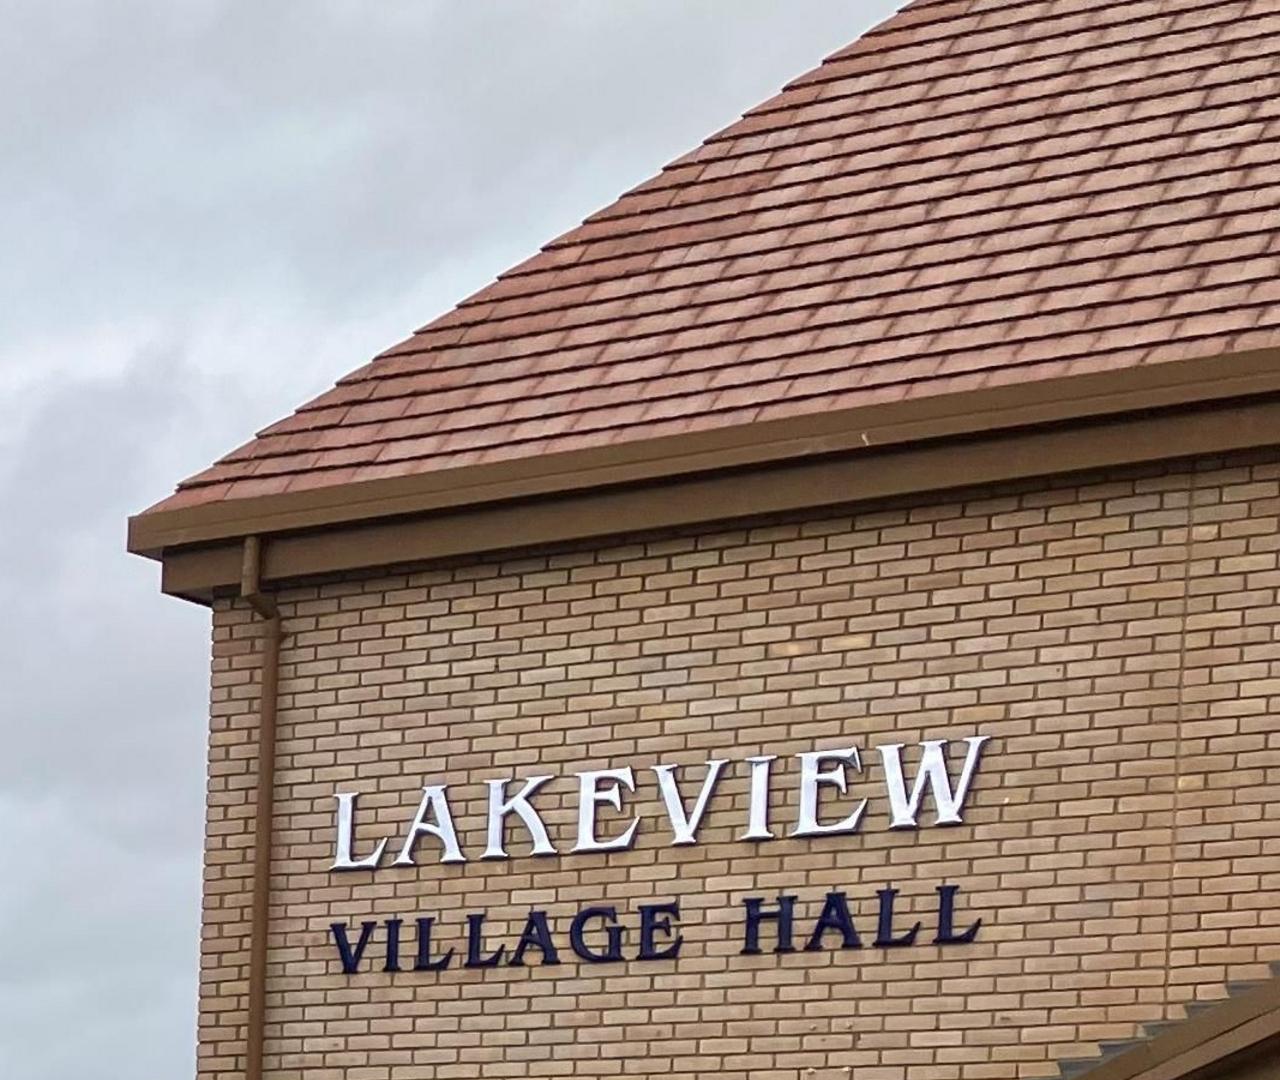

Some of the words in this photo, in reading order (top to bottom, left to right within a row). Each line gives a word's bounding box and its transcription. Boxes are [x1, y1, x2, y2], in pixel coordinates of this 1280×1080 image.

[329, 735, 991, 872] LAKEVIEW
[330, 901, 684, 975] VILLAGE
[740, 884, 982, 955] HALL
